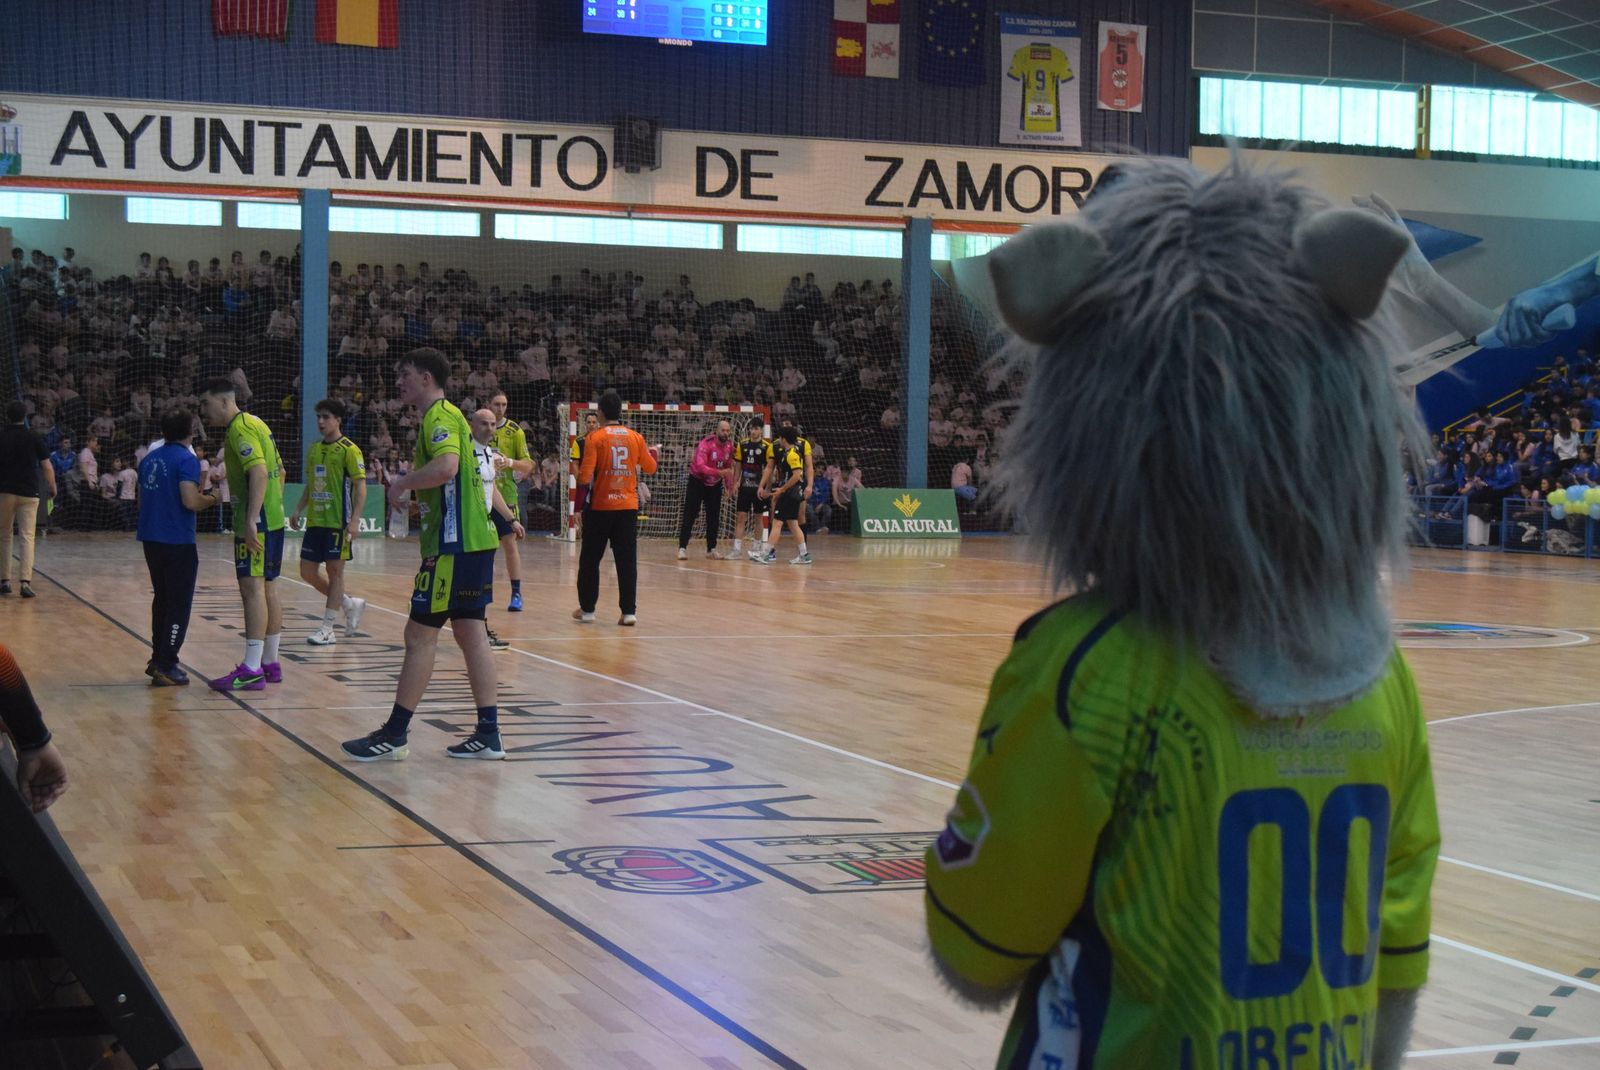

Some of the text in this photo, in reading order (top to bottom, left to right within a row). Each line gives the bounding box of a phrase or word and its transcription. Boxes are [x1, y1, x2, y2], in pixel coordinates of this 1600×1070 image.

[664, 38, 693, 47] MONDO
[1115, 43, 1128, 65] 5
[1035, 69, 1046, 91] 9
[50, 110, 1117, 216] AYUNTAMIENTO DE ZAMOR
[611, 446, 629, 470] 12
[863, 519, 958, 533] CAJA RURAL
[331, 532, 340, 547] 7
[1217, 784, 1391, 1001] 00
